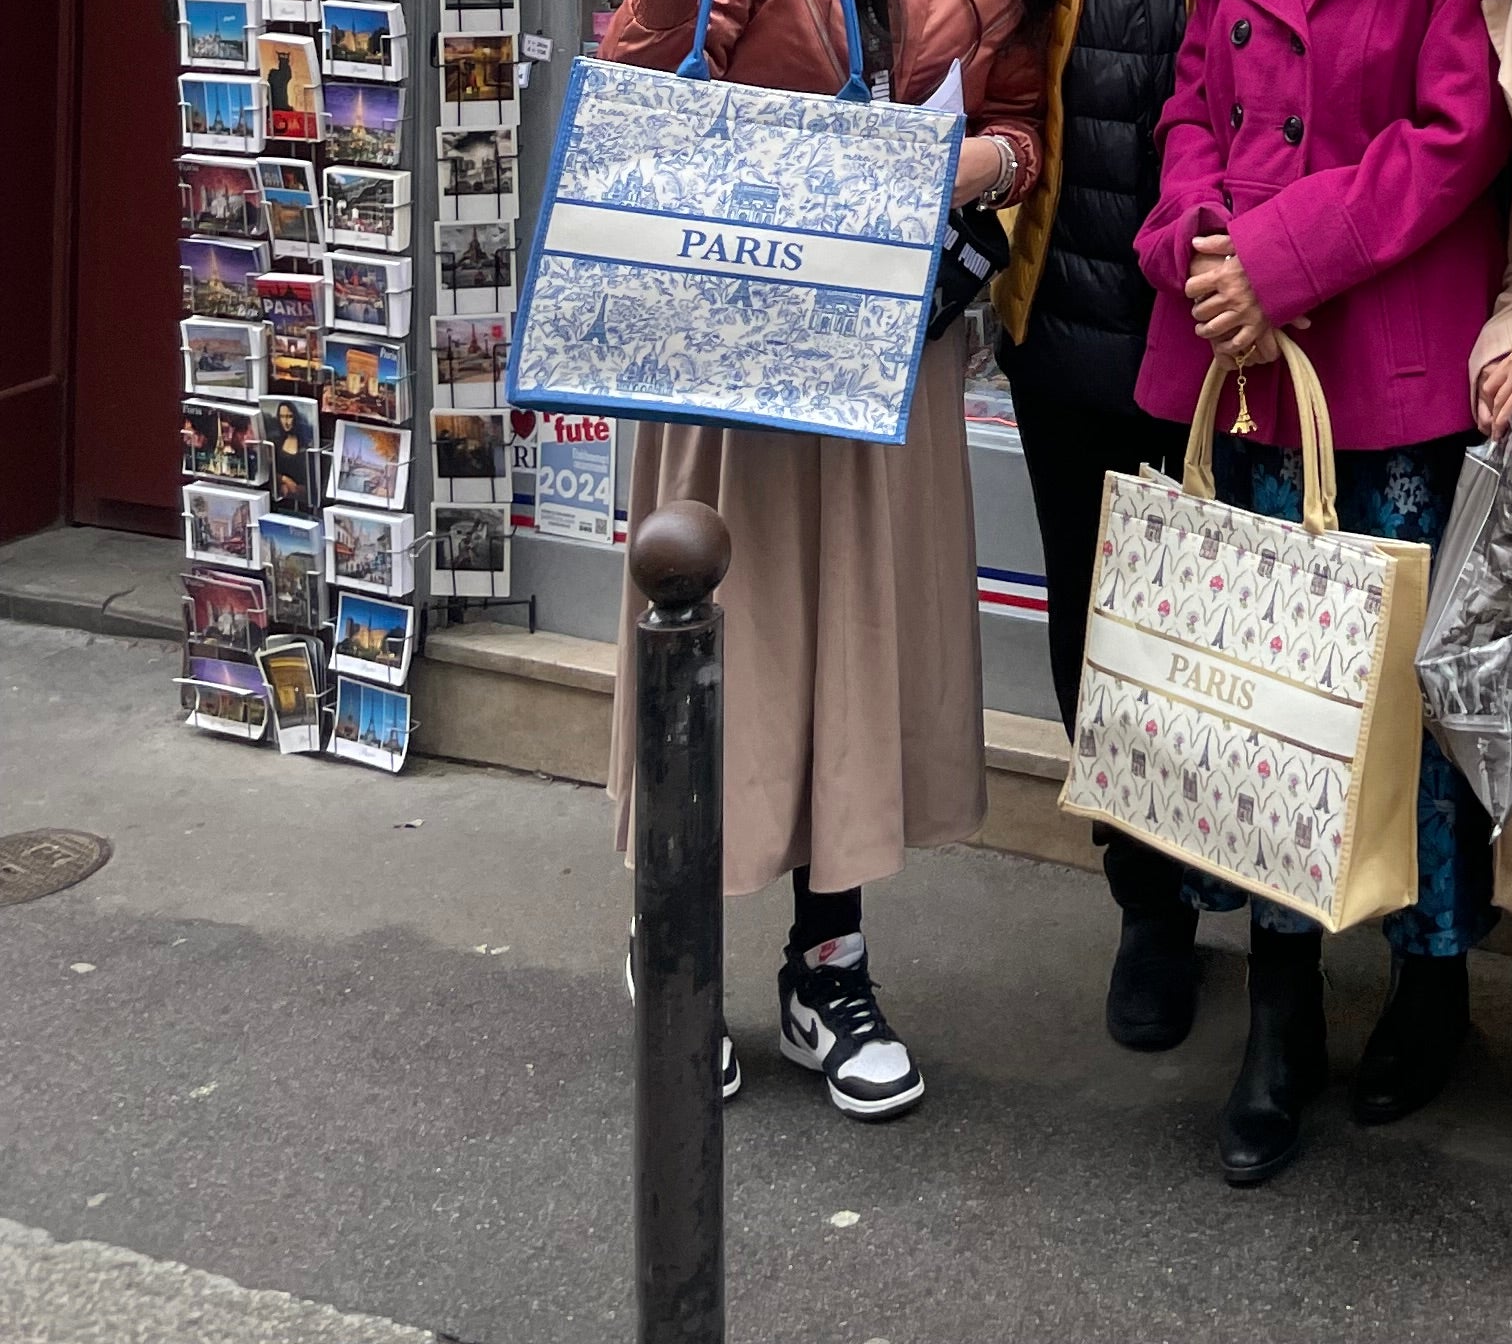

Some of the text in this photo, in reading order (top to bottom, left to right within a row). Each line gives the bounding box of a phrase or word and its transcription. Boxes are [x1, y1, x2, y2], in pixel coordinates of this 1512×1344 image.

[677, 228, 804, 272] PARIS
[262, 297, 313, 316] PARIS
[554, 414, 611, 444] futé
[539, 465, 611, 506] 2024
[1166, 652, 1256, 711] PARIS
